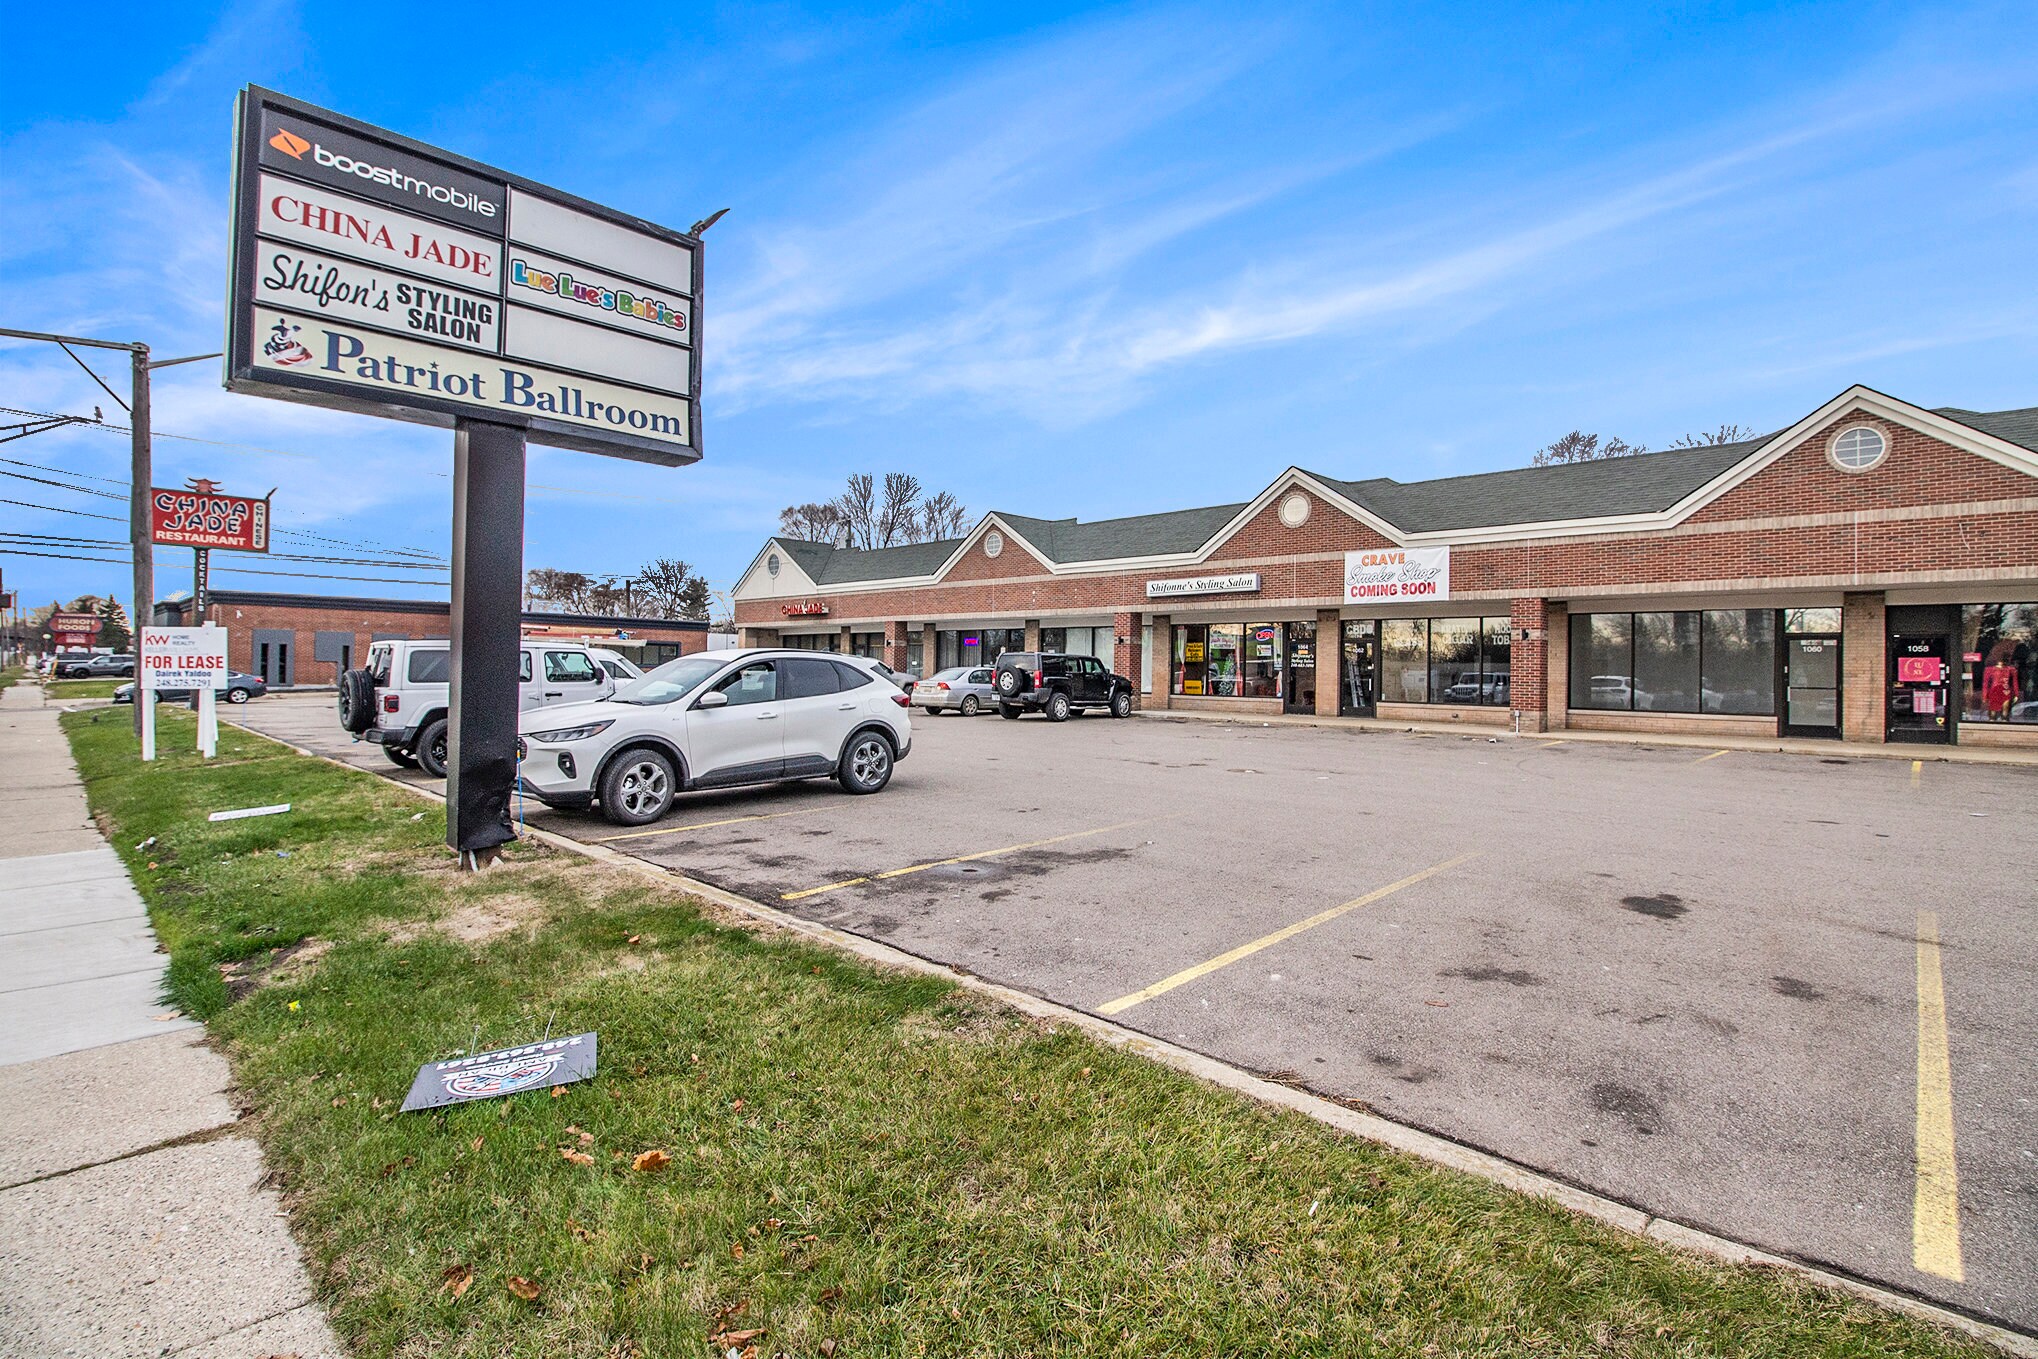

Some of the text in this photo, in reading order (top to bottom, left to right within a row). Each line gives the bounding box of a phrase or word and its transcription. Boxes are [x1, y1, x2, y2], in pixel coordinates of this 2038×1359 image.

[271, 195, 492, 277] CHINA JADE
[263, 254, 389, 312] Shifon's
[511, 259, 687, 331] Lue Lue's Babies
[396, 283, 492, 326] STYLING
[408, 309, 481, 343] SALON
[320, 329, 682, 437] Patriot Ballroom
[155, 493, 248, 521] CHINA
[163, 513, 241, 534] JADE
[255, 504, 264, 546] CHINESE
[155, 530, 247, 546] RESTAURANT
[1361, 552, 1406, 567] CRAVE
[198, 550, 206, 611] COCKTAILS
[1150, 577, 1253, 594] Shifonne's Styling Salon
[1346, 560, 1441, 586] Smoke Shop
[1350, 582, 1436, 598] COMING SOON
[781, 604, 803, 615] CHINA
[1255, 631, 1274, 639] OPEN
[1802, 645, 1823, 653] 1060
[145, 656, 224, 669] FOR LEASE
